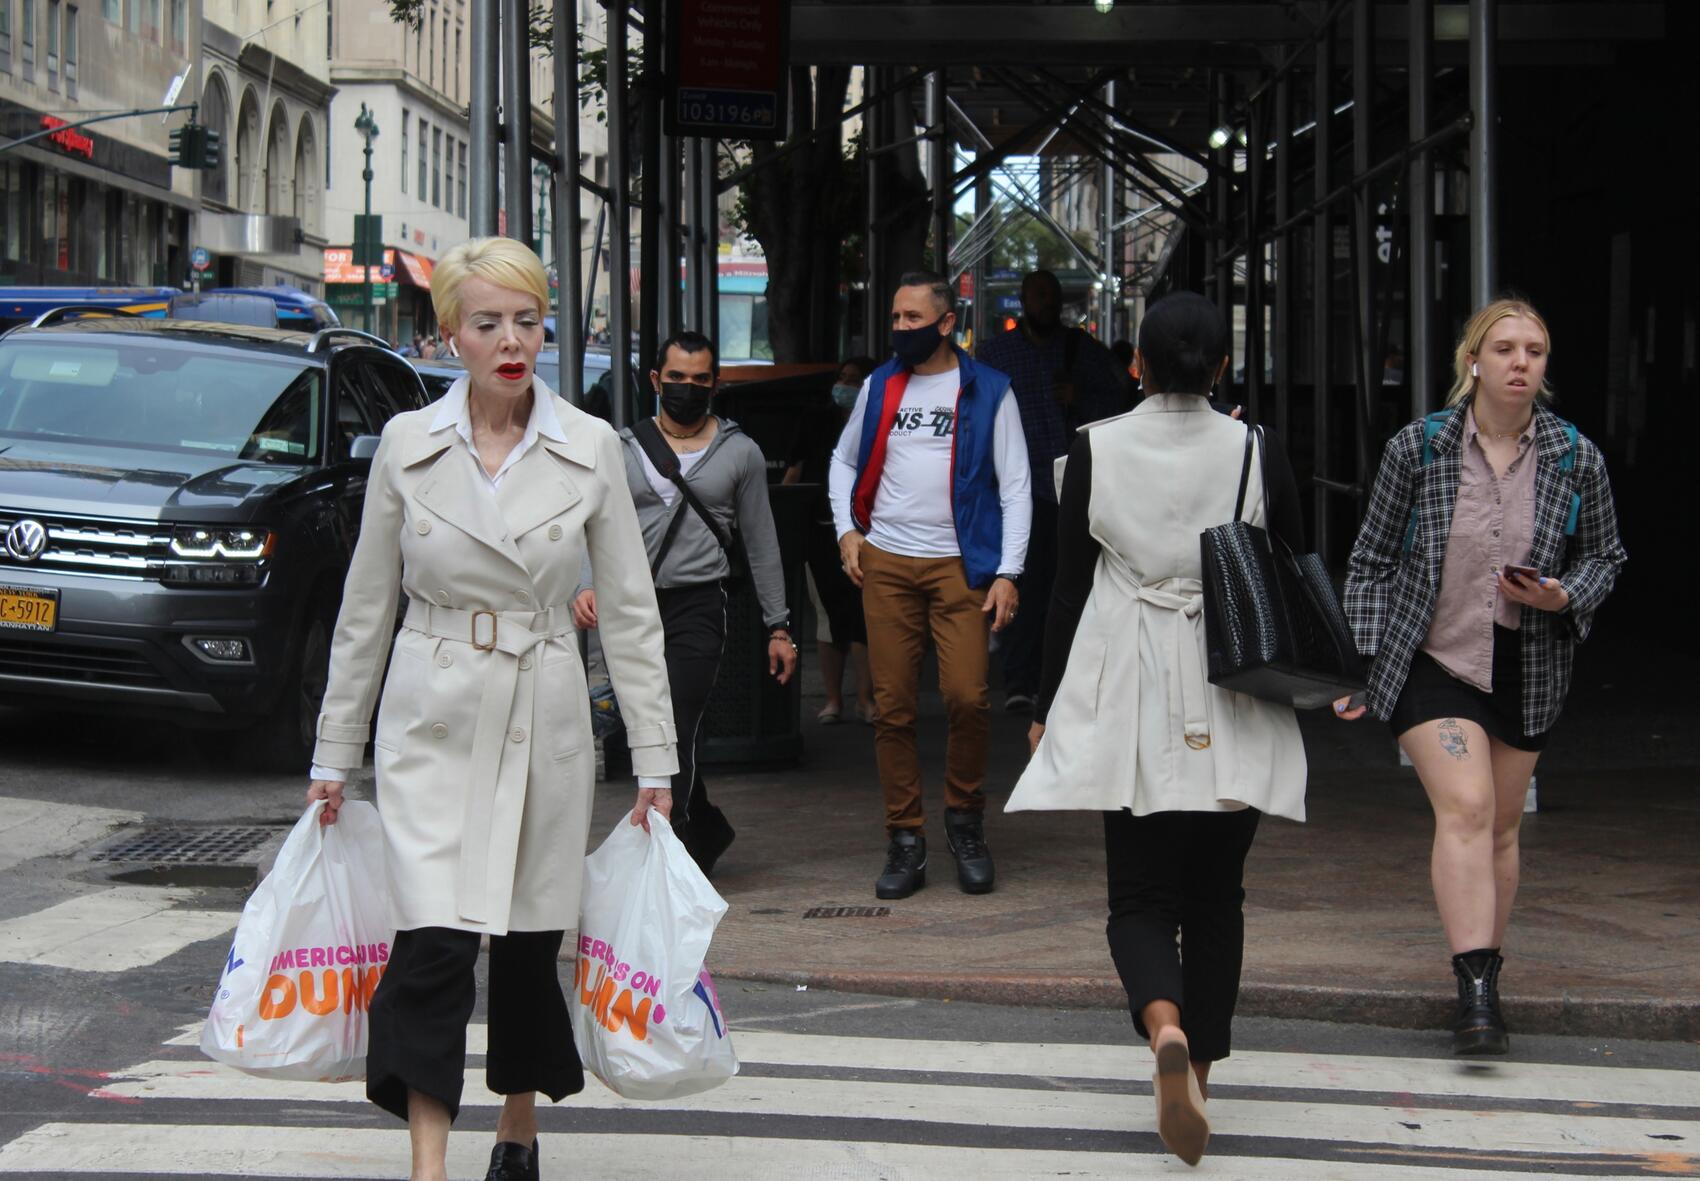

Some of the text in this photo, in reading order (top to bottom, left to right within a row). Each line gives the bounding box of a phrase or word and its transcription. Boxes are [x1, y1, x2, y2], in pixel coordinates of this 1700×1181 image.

[739, 17, 762, 32] Only
[682, 103, 751, 122] 103196
[630, 971, 661, 997] ON
